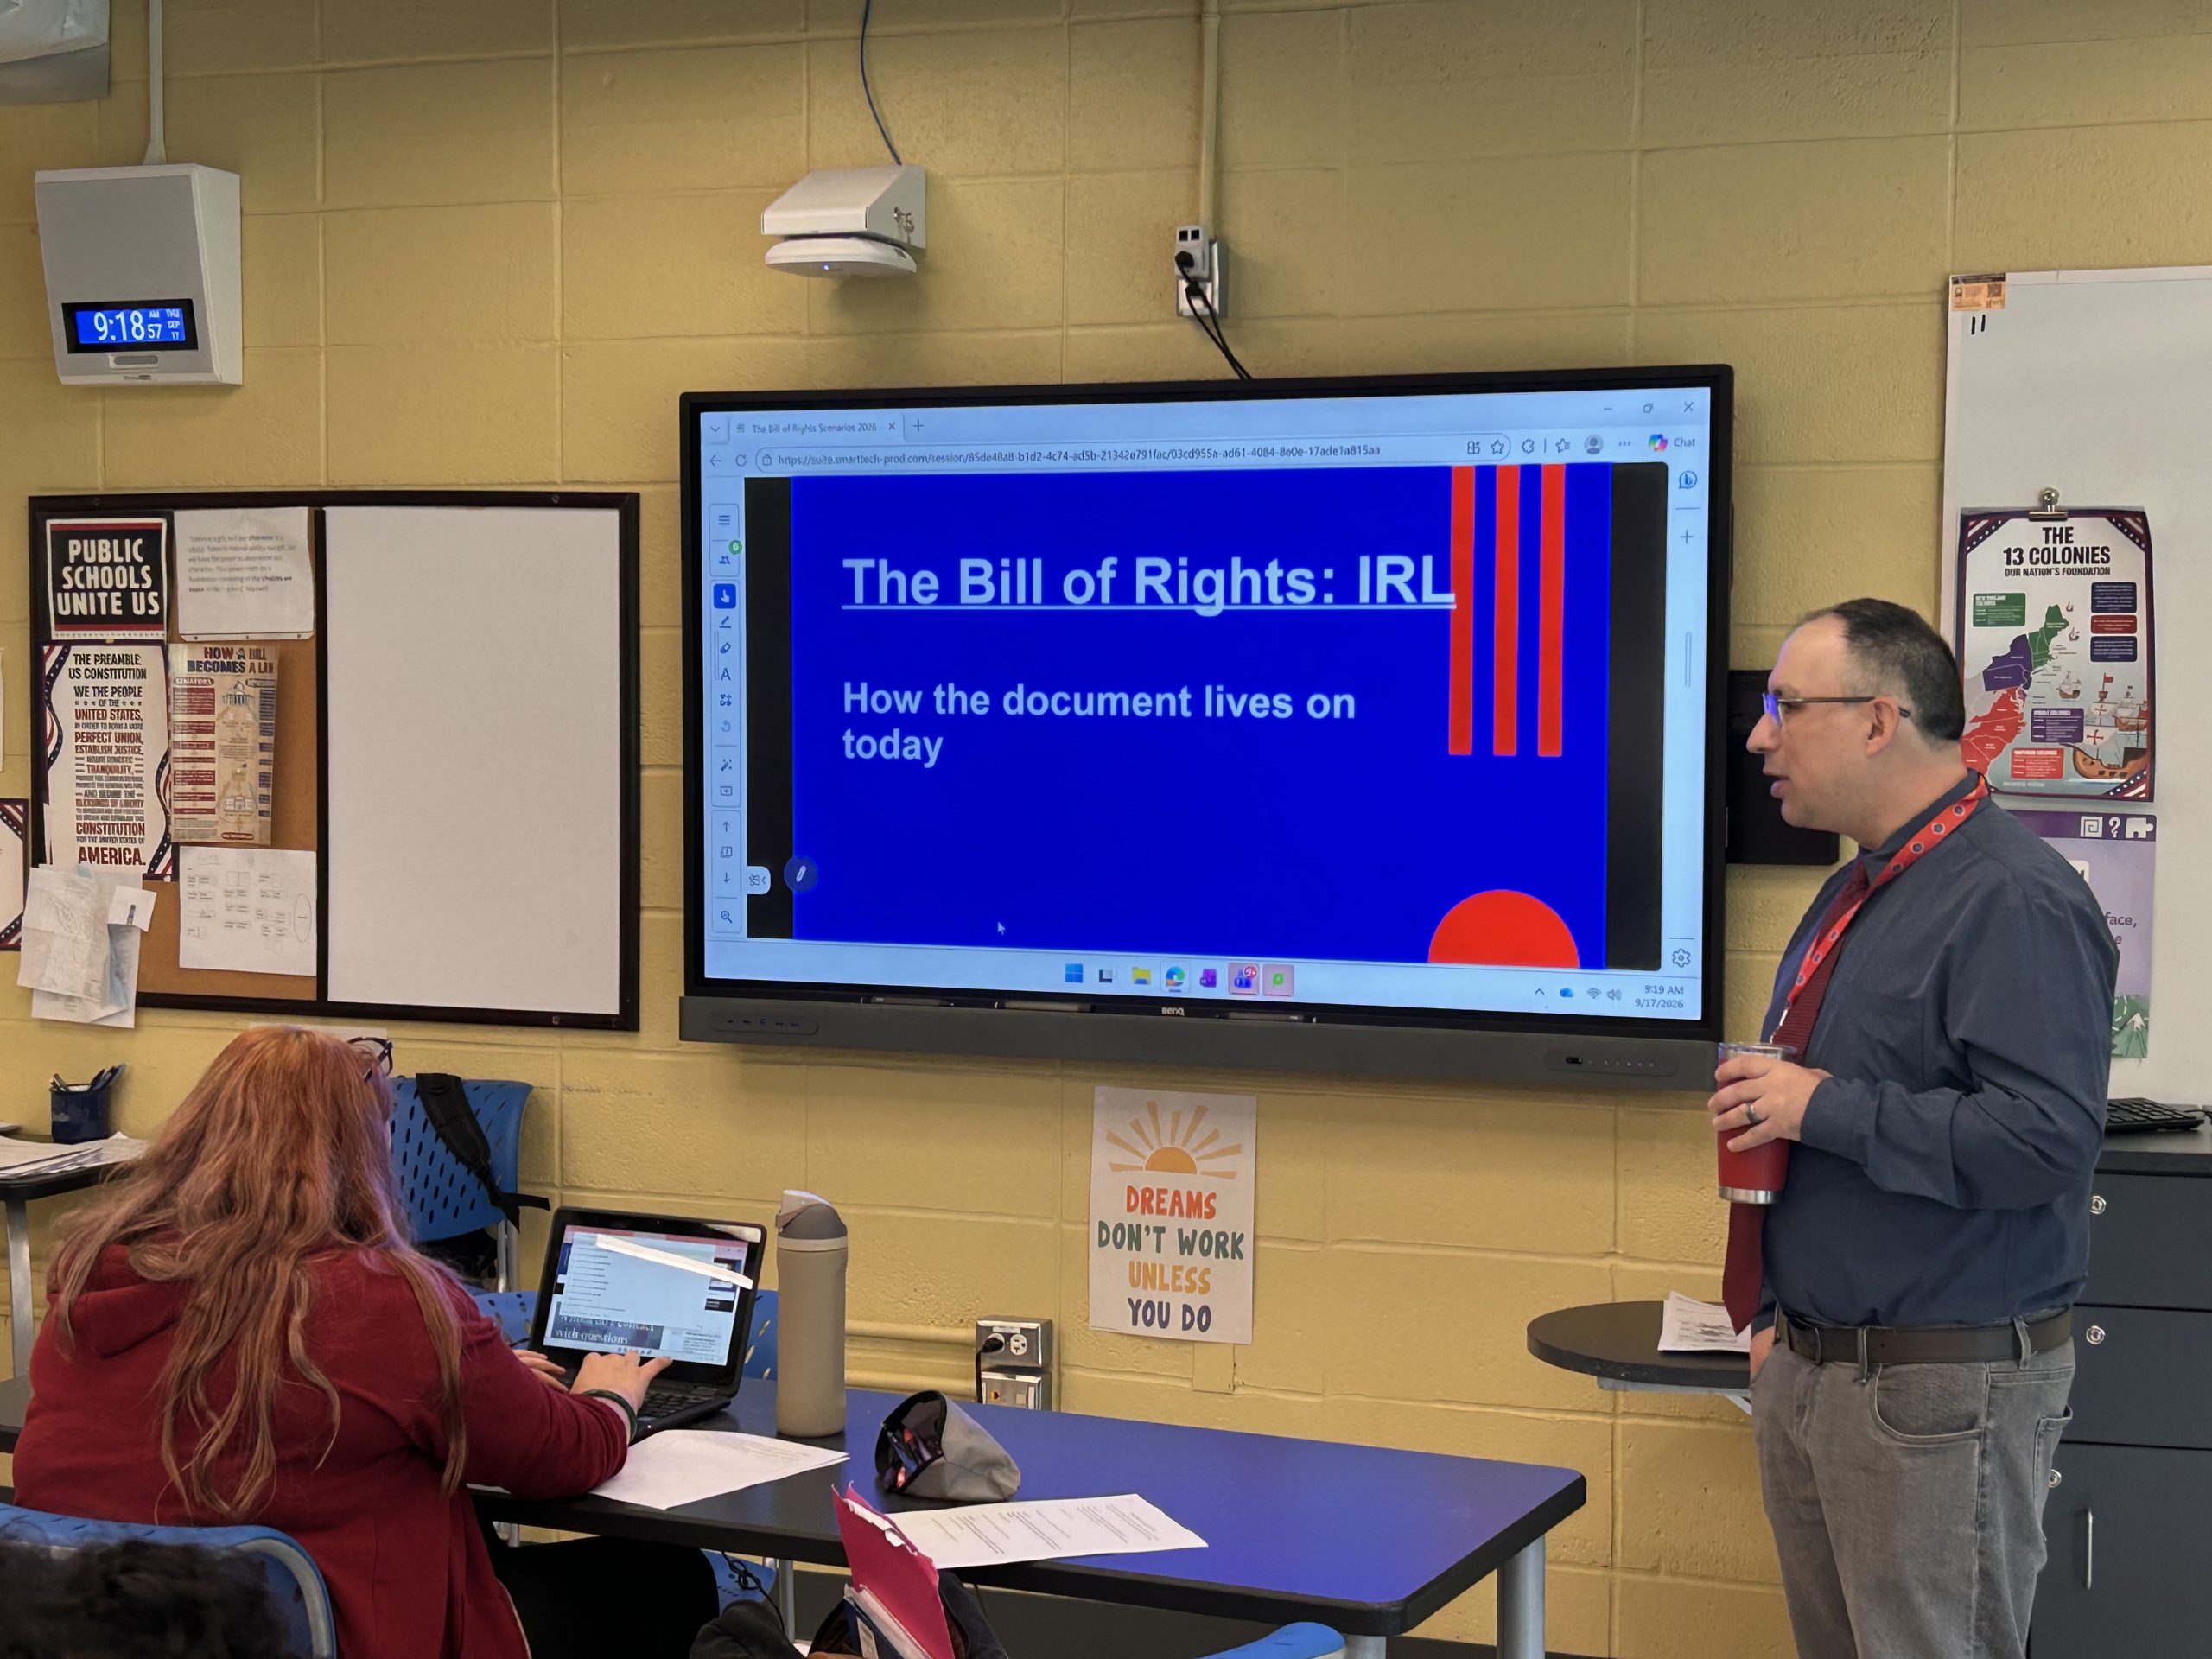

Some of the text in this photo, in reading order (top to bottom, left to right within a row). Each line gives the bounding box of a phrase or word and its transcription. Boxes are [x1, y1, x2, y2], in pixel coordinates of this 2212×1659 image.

[149, 310, 160, 319] AM
[93, 310, 145, 341] 9:18
[148, 324, 162, 340] 57
[171, 332, 179, 340] 17
[753, 423, 766, 434] The
[768, 424, 780, 433] Bill
[782, 423, 791, 432] of
[792, 423, 817, 435] Rights
[819, 423, 855, 433] Scenarios
[1674, 437, 1696, 448] Chat
[2042, 526, 2075, 545] THE
[68, 538, 144, 563] PUBLIC
[2003, 546, 2111, 566] 13 COLONIES
[62, 565, 152, 590] SCHOOLS
[2004, 566, 2111, 577] OUR NATION'S FOUNDATION
[842, 555, 1456, 617] The Bill of Rights: IRL
[57, 591, 160, 616] UNITE US
[73, 653, 92, 666] THE
[203, 647, 234, 660] HOW
[68, 667, 147, 680] US CONSTITUTION
[187, 660, 246, 674] BECOMES
[248, 663, 257, 674] A
[73, 686, 143, 698] WE THE PEOPLE
[843, 682, 1356, 720] How the document lives on
[74, 709, 143, 722] UNITED STATES,
[74, 732, 144, 745] PERFECT UNION,
[75, 744, 144, 756] ESTABLISH JUSTICE,
[842, 728, 944, 769] today
[76, 822, 146, 836] CONSTITUTION
[79, 846, 147, 866] AMERICA.
[1644, 985, 1684, 995] 9:19 AM
[1635, 999, 1684, 1009] 9/17/2026
[1125, 1185, 1217, 1220] DREAMS
[1097, 1220, 1245, 1261] DON'T WORK
[1128, 1260, 1211, 1295] UNLESS
[1127, 1297, 1212, 1333] YOU DO
